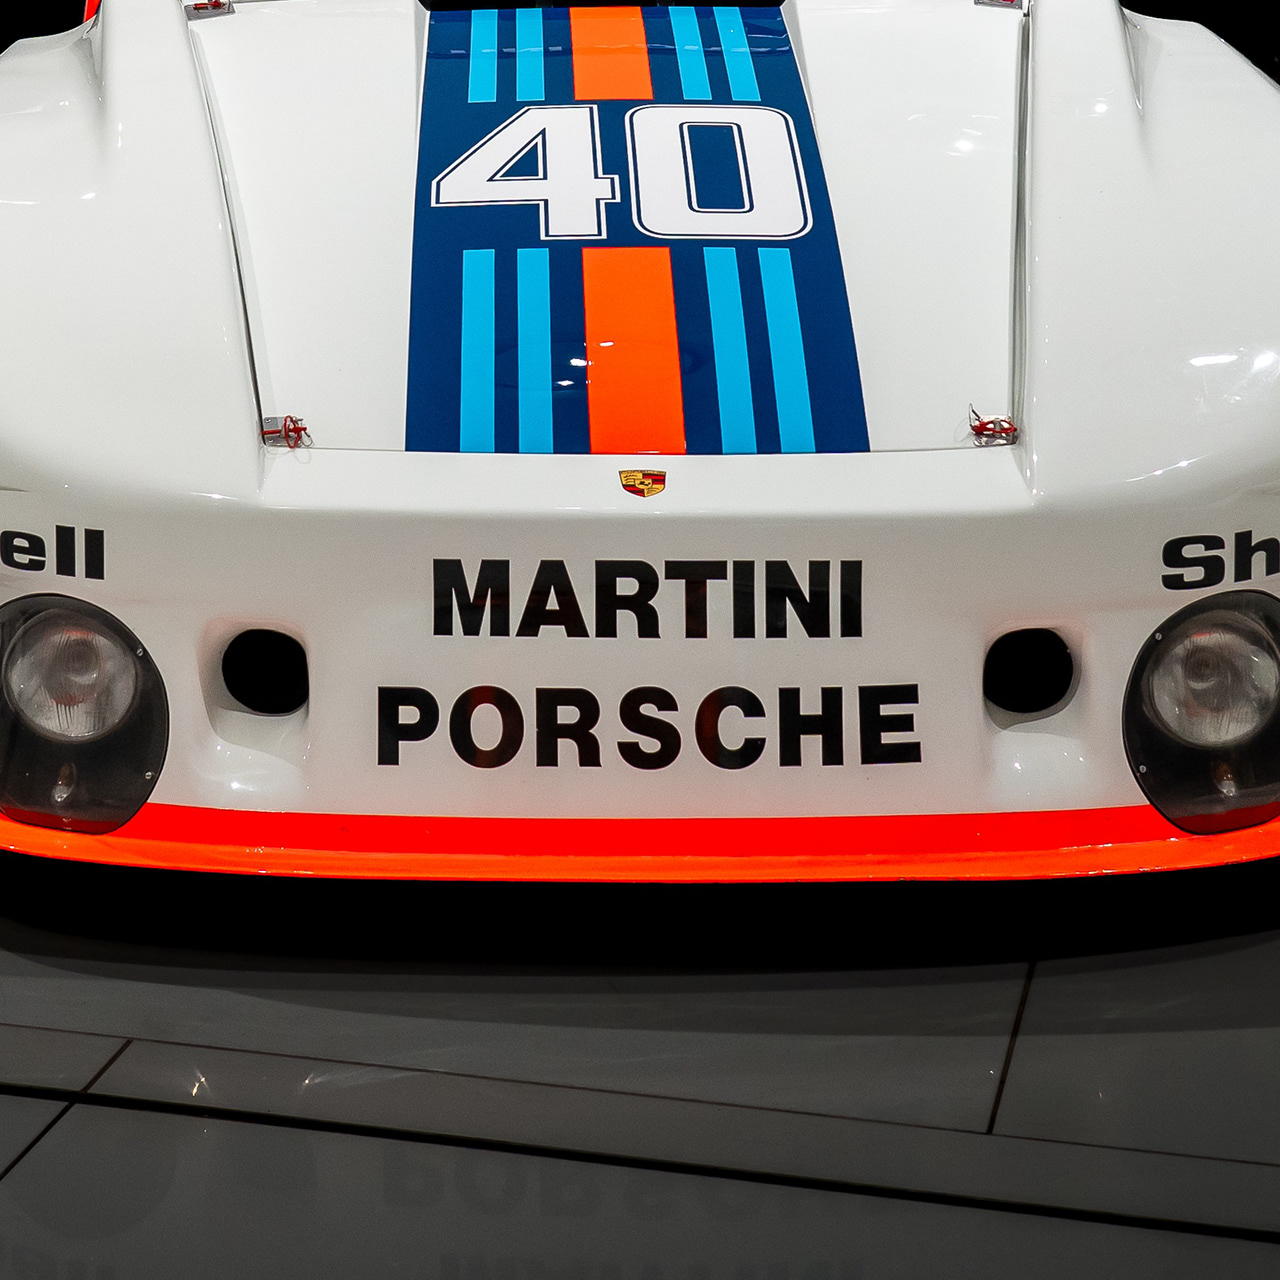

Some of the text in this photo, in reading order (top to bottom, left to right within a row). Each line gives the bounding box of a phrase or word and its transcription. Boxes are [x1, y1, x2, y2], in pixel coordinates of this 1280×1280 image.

[431, 104, 813, 240] 40
[432, 558, 863, 639] MARTINI
[377, 684, 922, 770] PORSCHE
